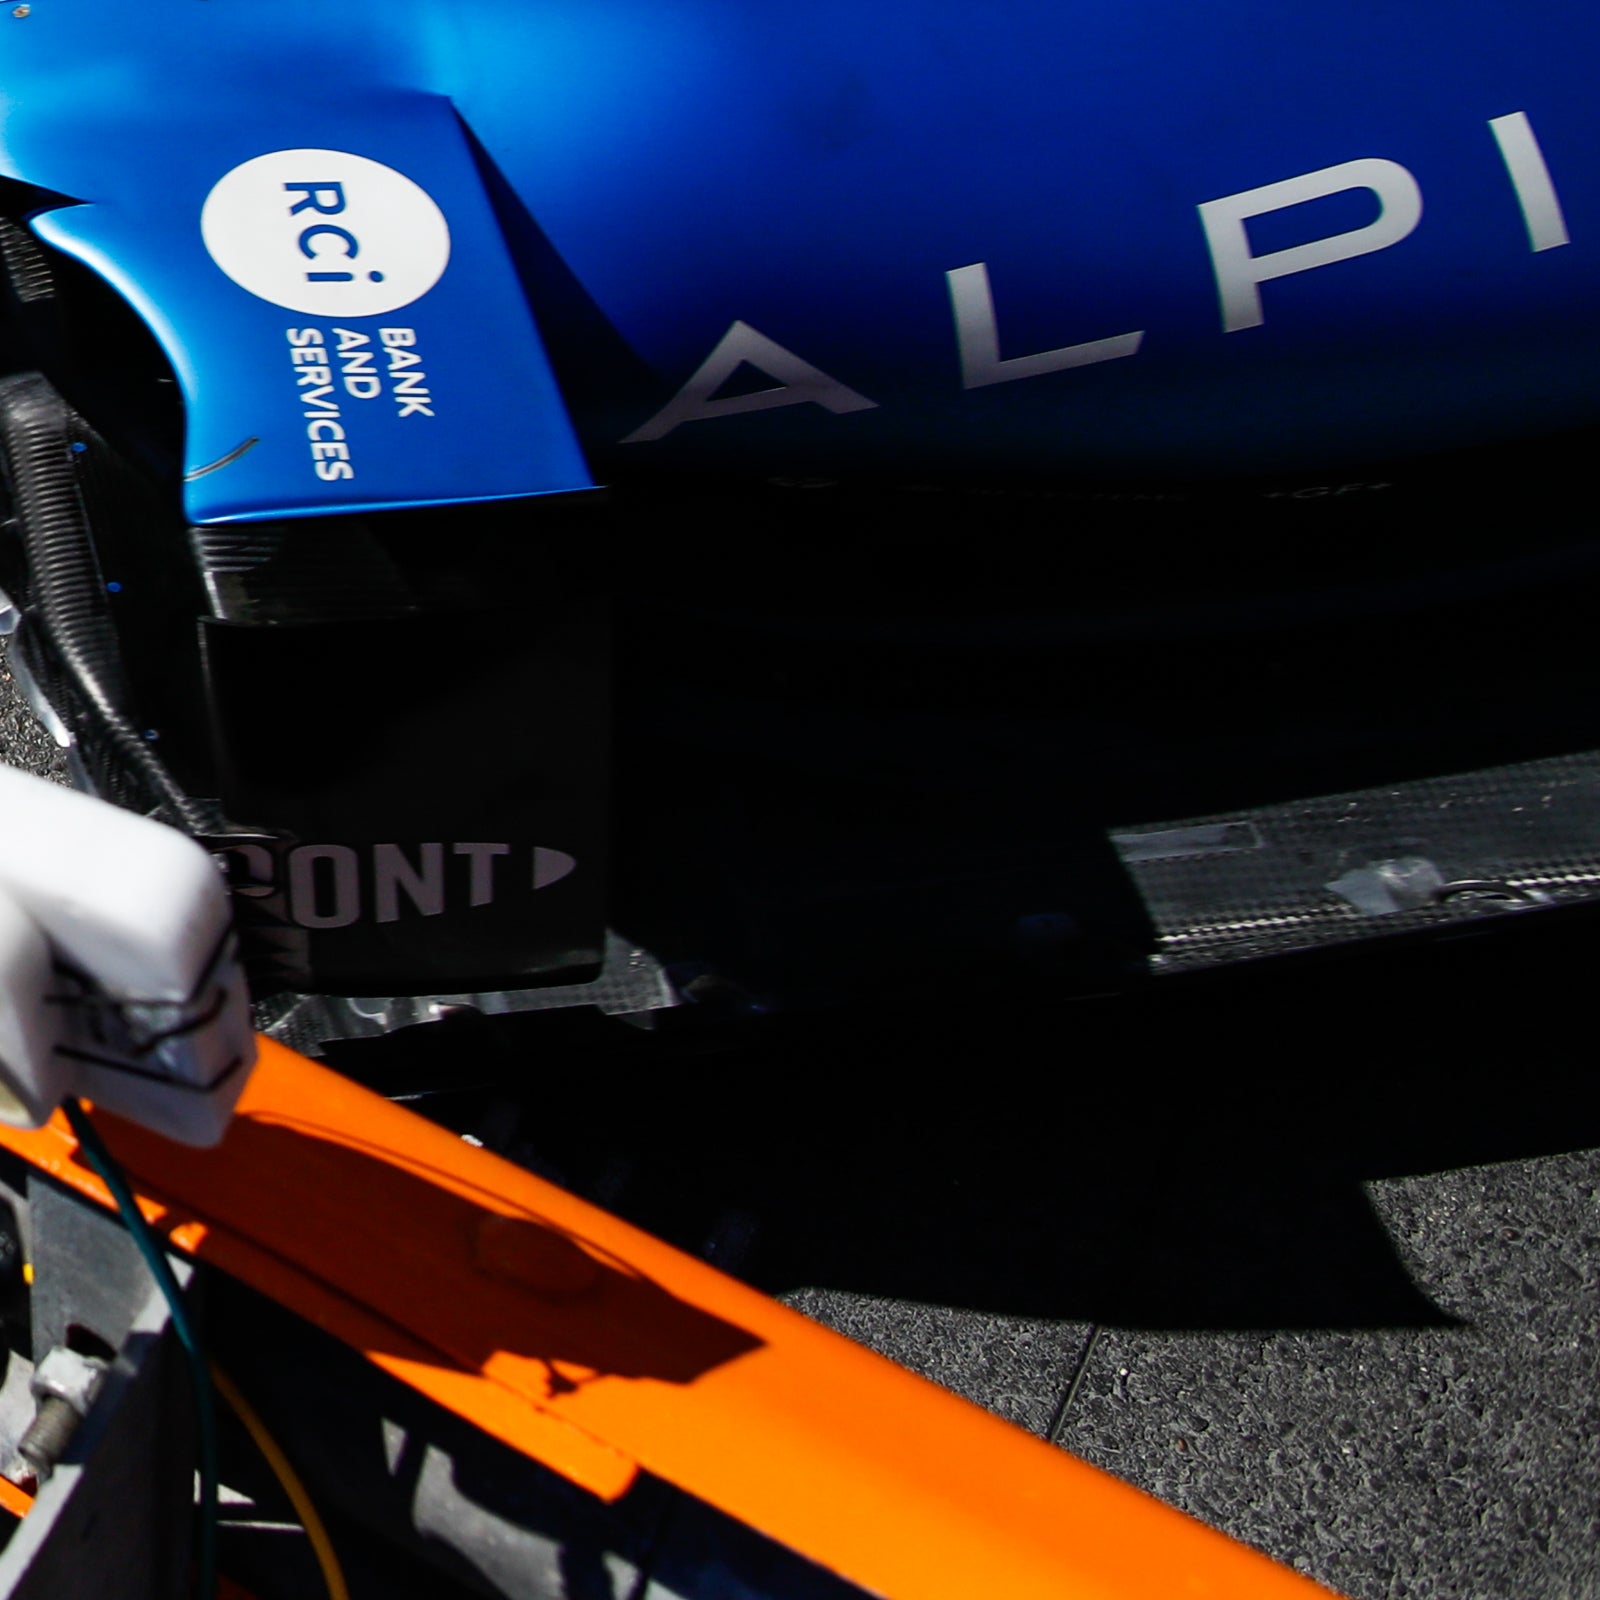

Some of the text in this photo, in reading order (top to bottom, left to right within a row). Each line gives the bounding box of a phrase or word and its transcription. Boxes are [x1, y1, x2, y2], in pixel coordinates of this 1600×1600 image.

[282, 181, 385, 284] RCi
[286, 327, 354, 482] SERVICES
[334, 327, 381, 400] AND
[379, 327, 435, 418] BANK
